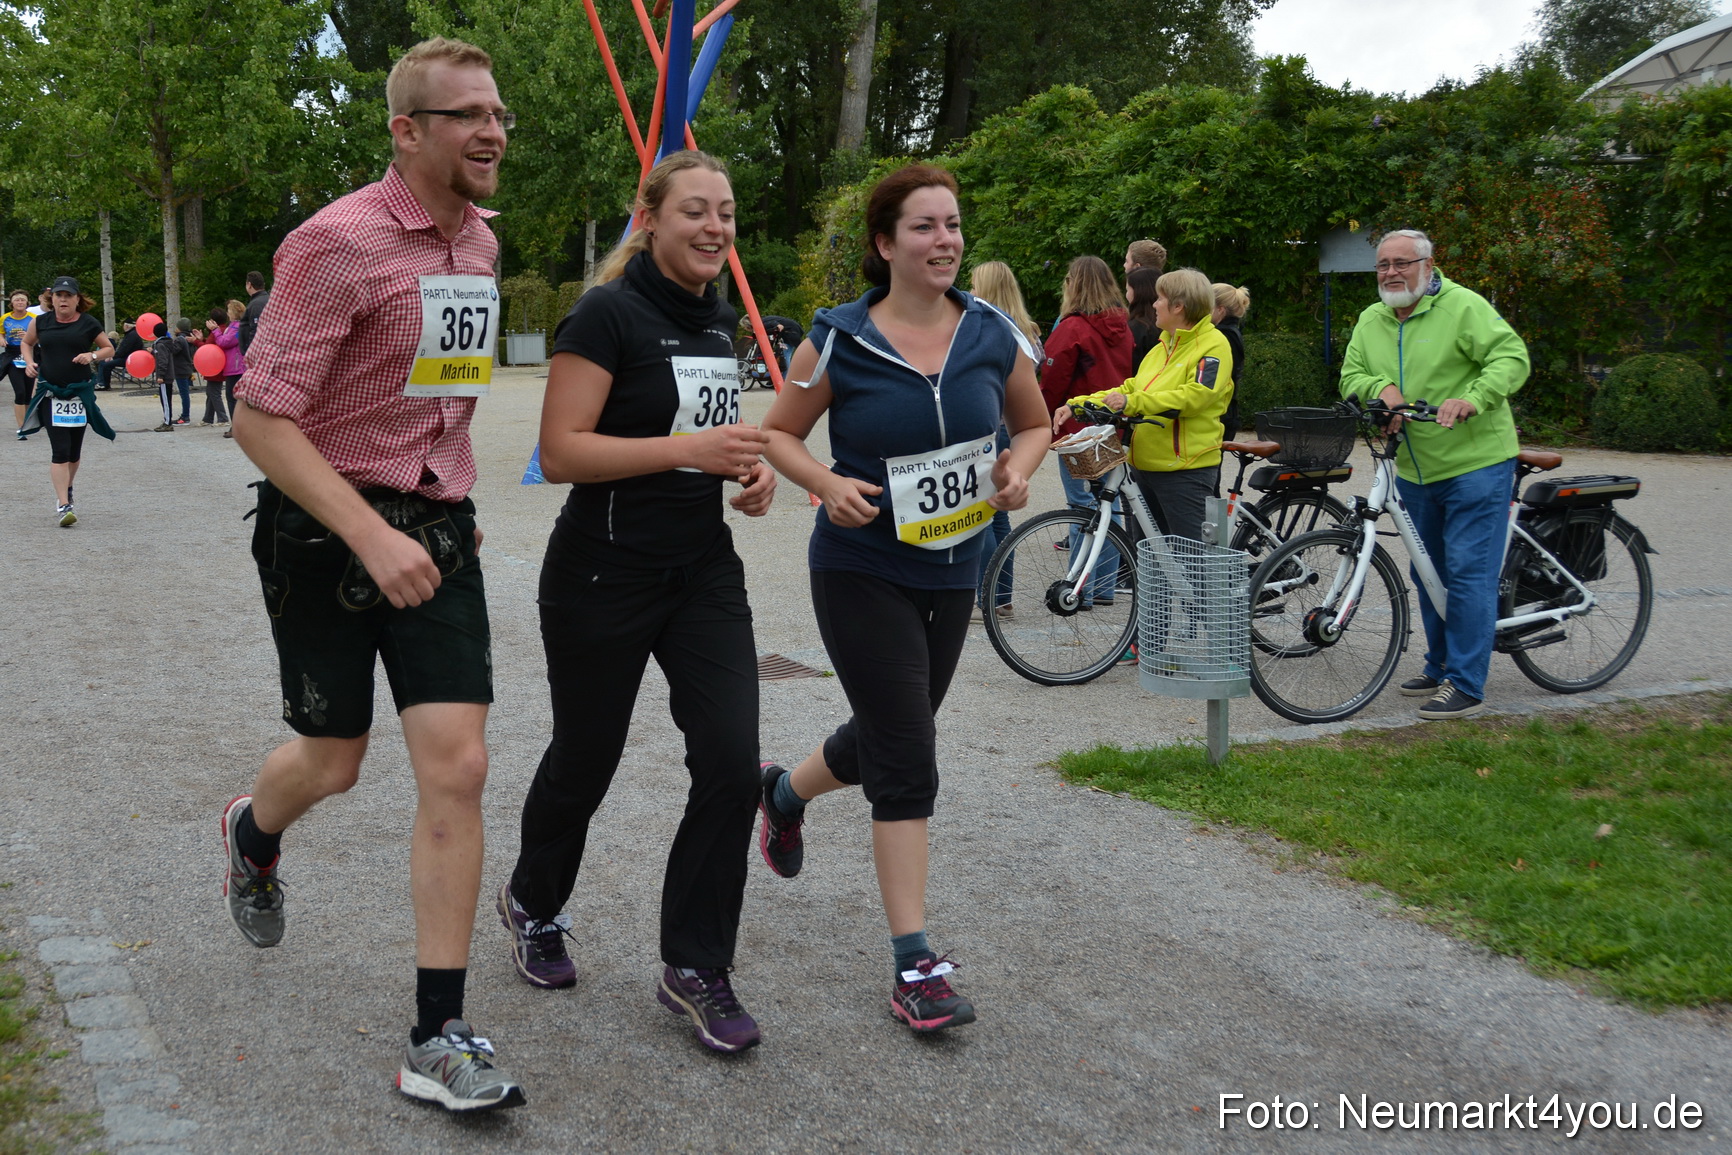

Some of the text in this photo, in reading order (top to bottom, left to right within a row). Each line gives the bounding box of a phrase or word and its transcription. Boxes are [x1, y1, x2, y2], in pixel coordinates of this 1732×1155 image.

[423, 288, 489, 300] PARTL Neumarkt
[440, 306, 489, 352] 367
[440, 362, 479, 381] Martin
[677, 368, 710, 379] PARTL
[55, 402, 84, 415] 2439
[694, 385, 739, 428] 385
[891, 449, 981, 477] PARTL Neumarkt
[917, 463, 979, 515] 384
[919, 509, 984, 541] Alexandra
